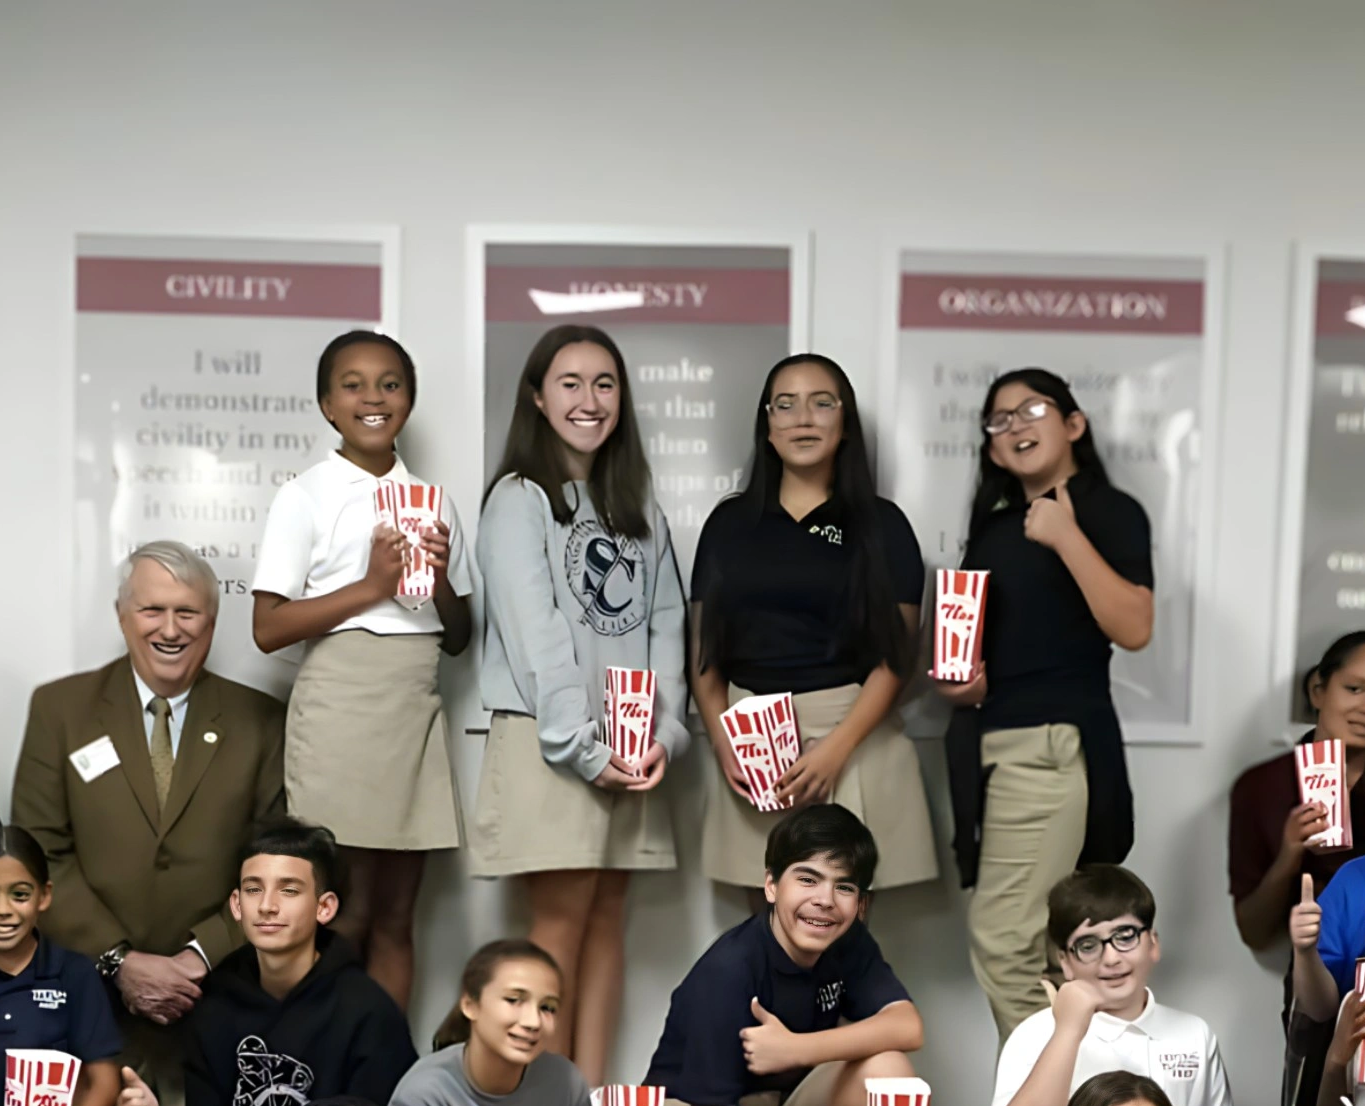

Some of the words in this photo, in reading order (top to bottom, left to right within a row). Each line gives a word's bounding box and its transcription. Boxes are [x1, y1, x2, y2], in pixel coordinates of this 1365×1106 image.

[165, 274, 292, 300] CIVILITY
[938, 287, 1168, 320] ORGANIZATION
[194, 350, 202, 374] I
[212, 351, 262, 375] will
[639, 357, 713, 382] make
[140, 385, 313, 413] demonstrate
[665, 393, 715, 418] that
[136, 422, 229, 452] civility
[238, 424, 264, 450] in
[273, 432, 317, 457] my
[143, 494, 161, 520] it
[170, 495, 256, 523] within
